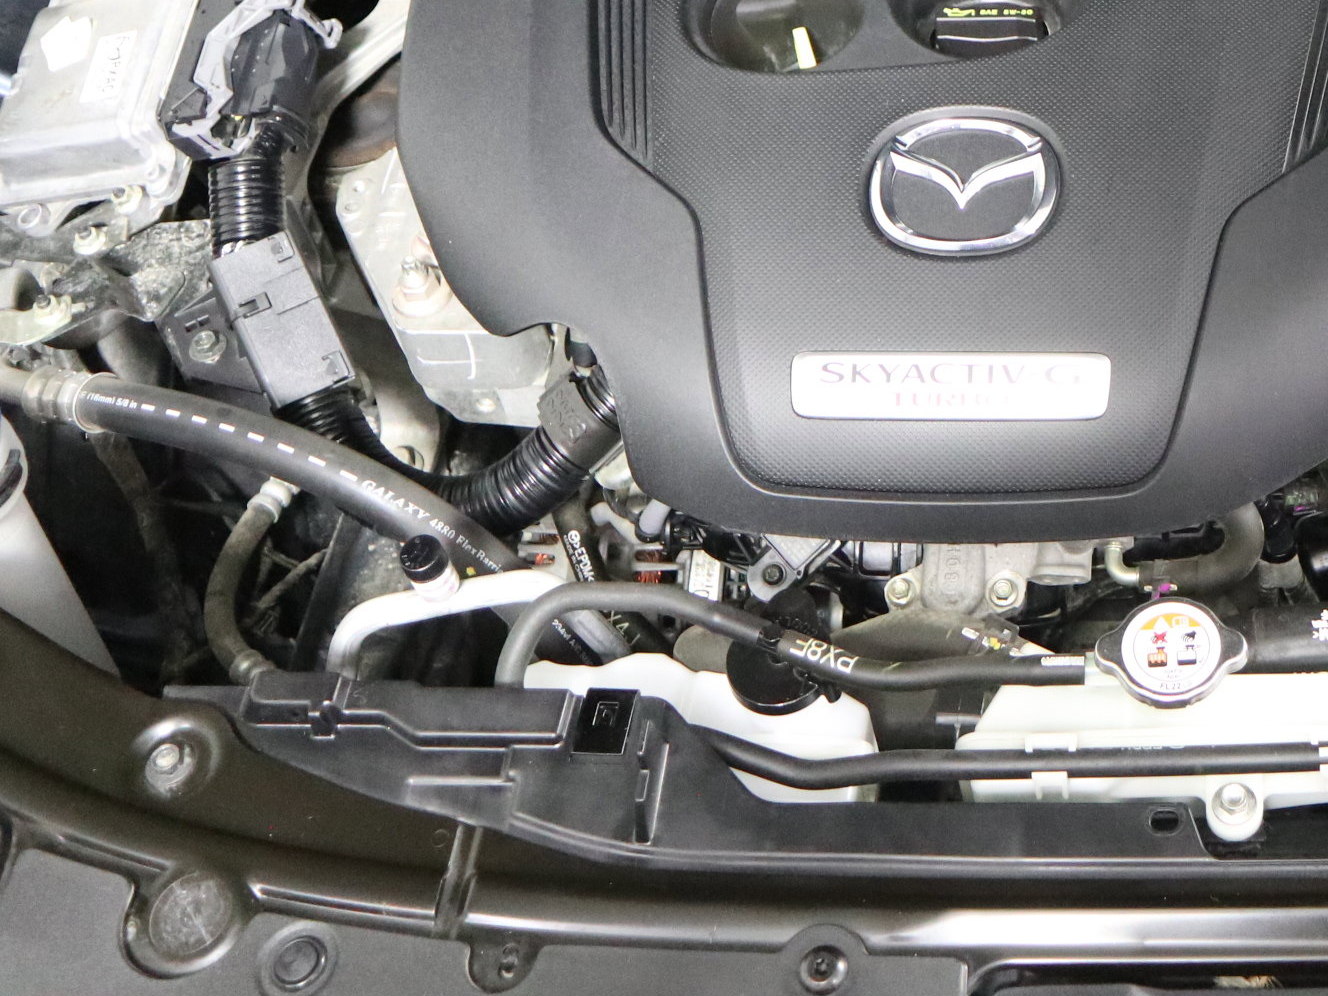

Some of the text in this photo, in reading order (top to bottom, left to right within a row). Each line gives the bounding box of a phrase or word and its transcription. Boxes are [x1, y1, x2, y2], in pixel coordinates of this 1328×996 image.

[819, 361, 1082, 385] SKYACTIV-G
[361, 478, 431, 521] GALAXY
[429, 518, 456, 540] 4880
[789, 637, 860, 674] PX8F
